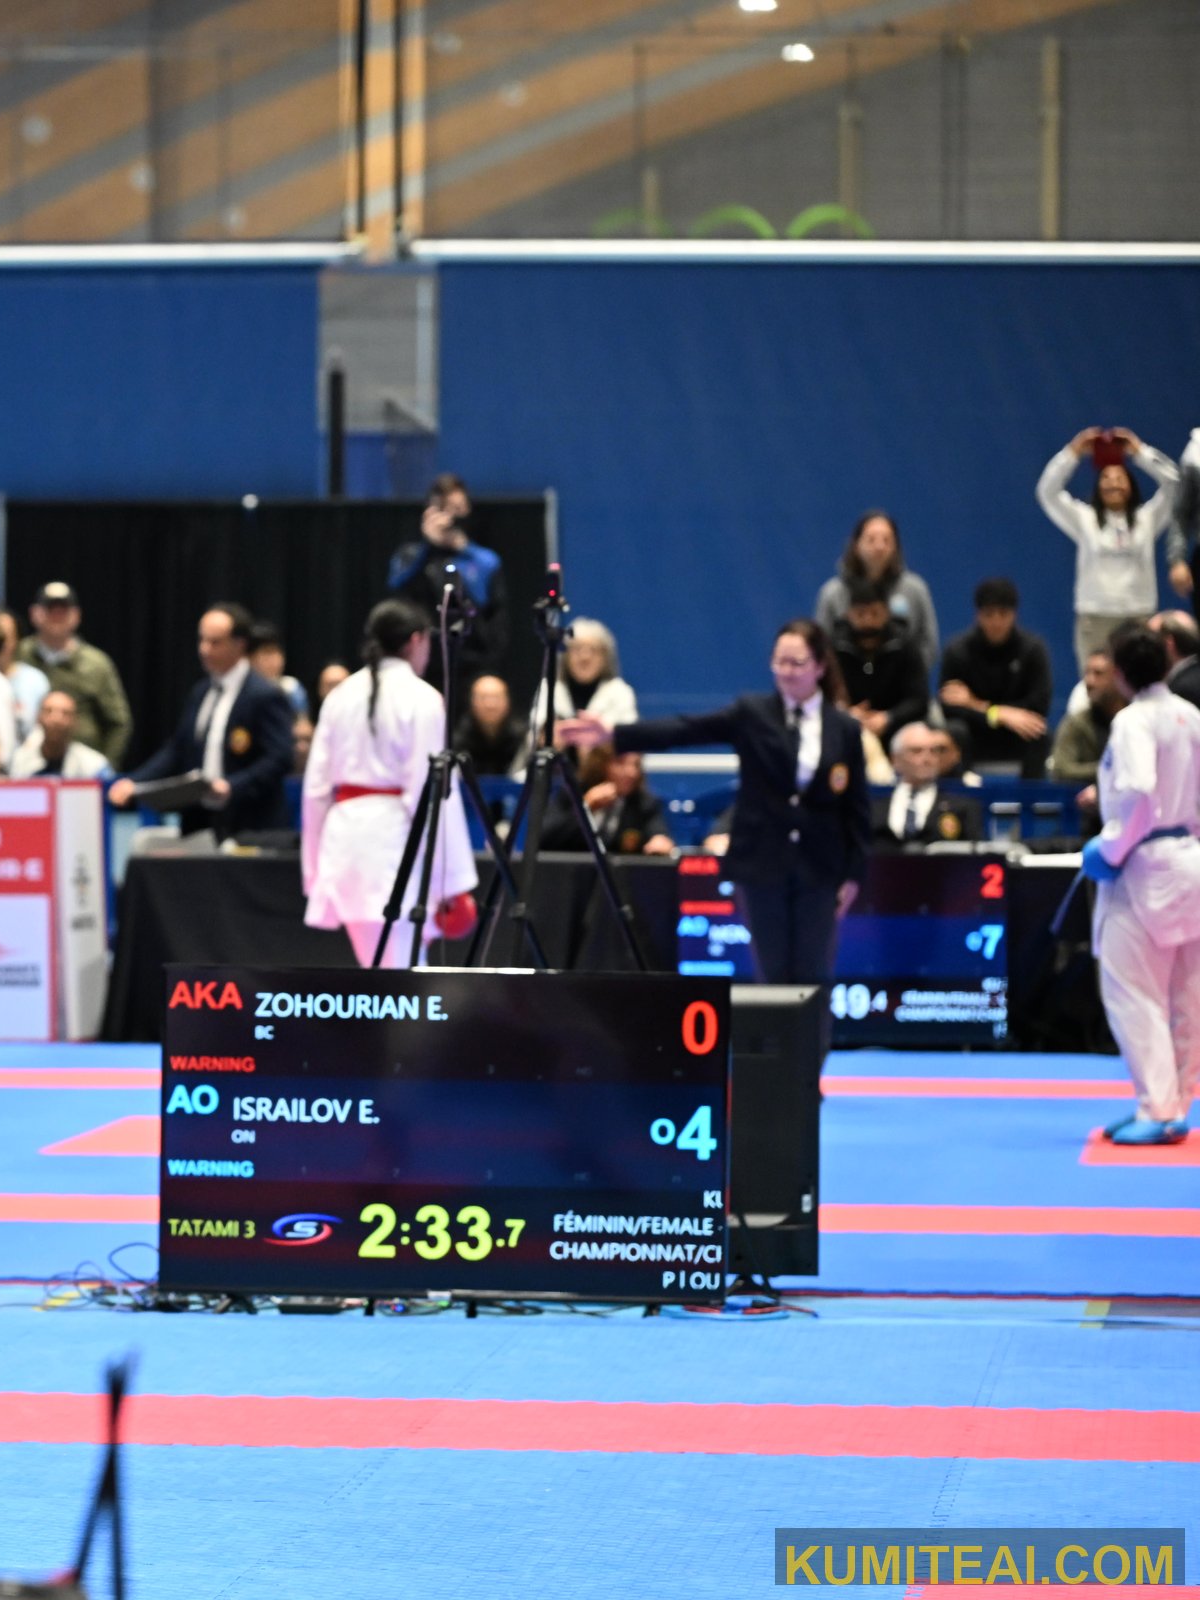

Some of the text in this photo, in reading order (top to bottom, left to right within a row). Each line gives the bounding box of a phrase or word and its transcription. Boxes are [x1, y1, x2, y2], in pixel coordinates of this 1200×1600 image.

[979, 862, 1005, 898] 2
[980, 923, 1005, 960] 7
[168, 980, 449, 1021] AKA ZOHOURIAN E.
[254, 1024, 275, 1040] BC
[681, 1000, 718, 1055] 0
[169, 1055, 256, 1073] WARNING
[166, 1084, 380, 1124] AO ISRAILOV E.
[231, 1128, 256, 1144] ON
[167, 1159, 255, 1178] WARNING
[167, 1218, 256, 1239] TATAMI 3
[552, 1209, 714, 1237] FÉMININ/FEMALE
